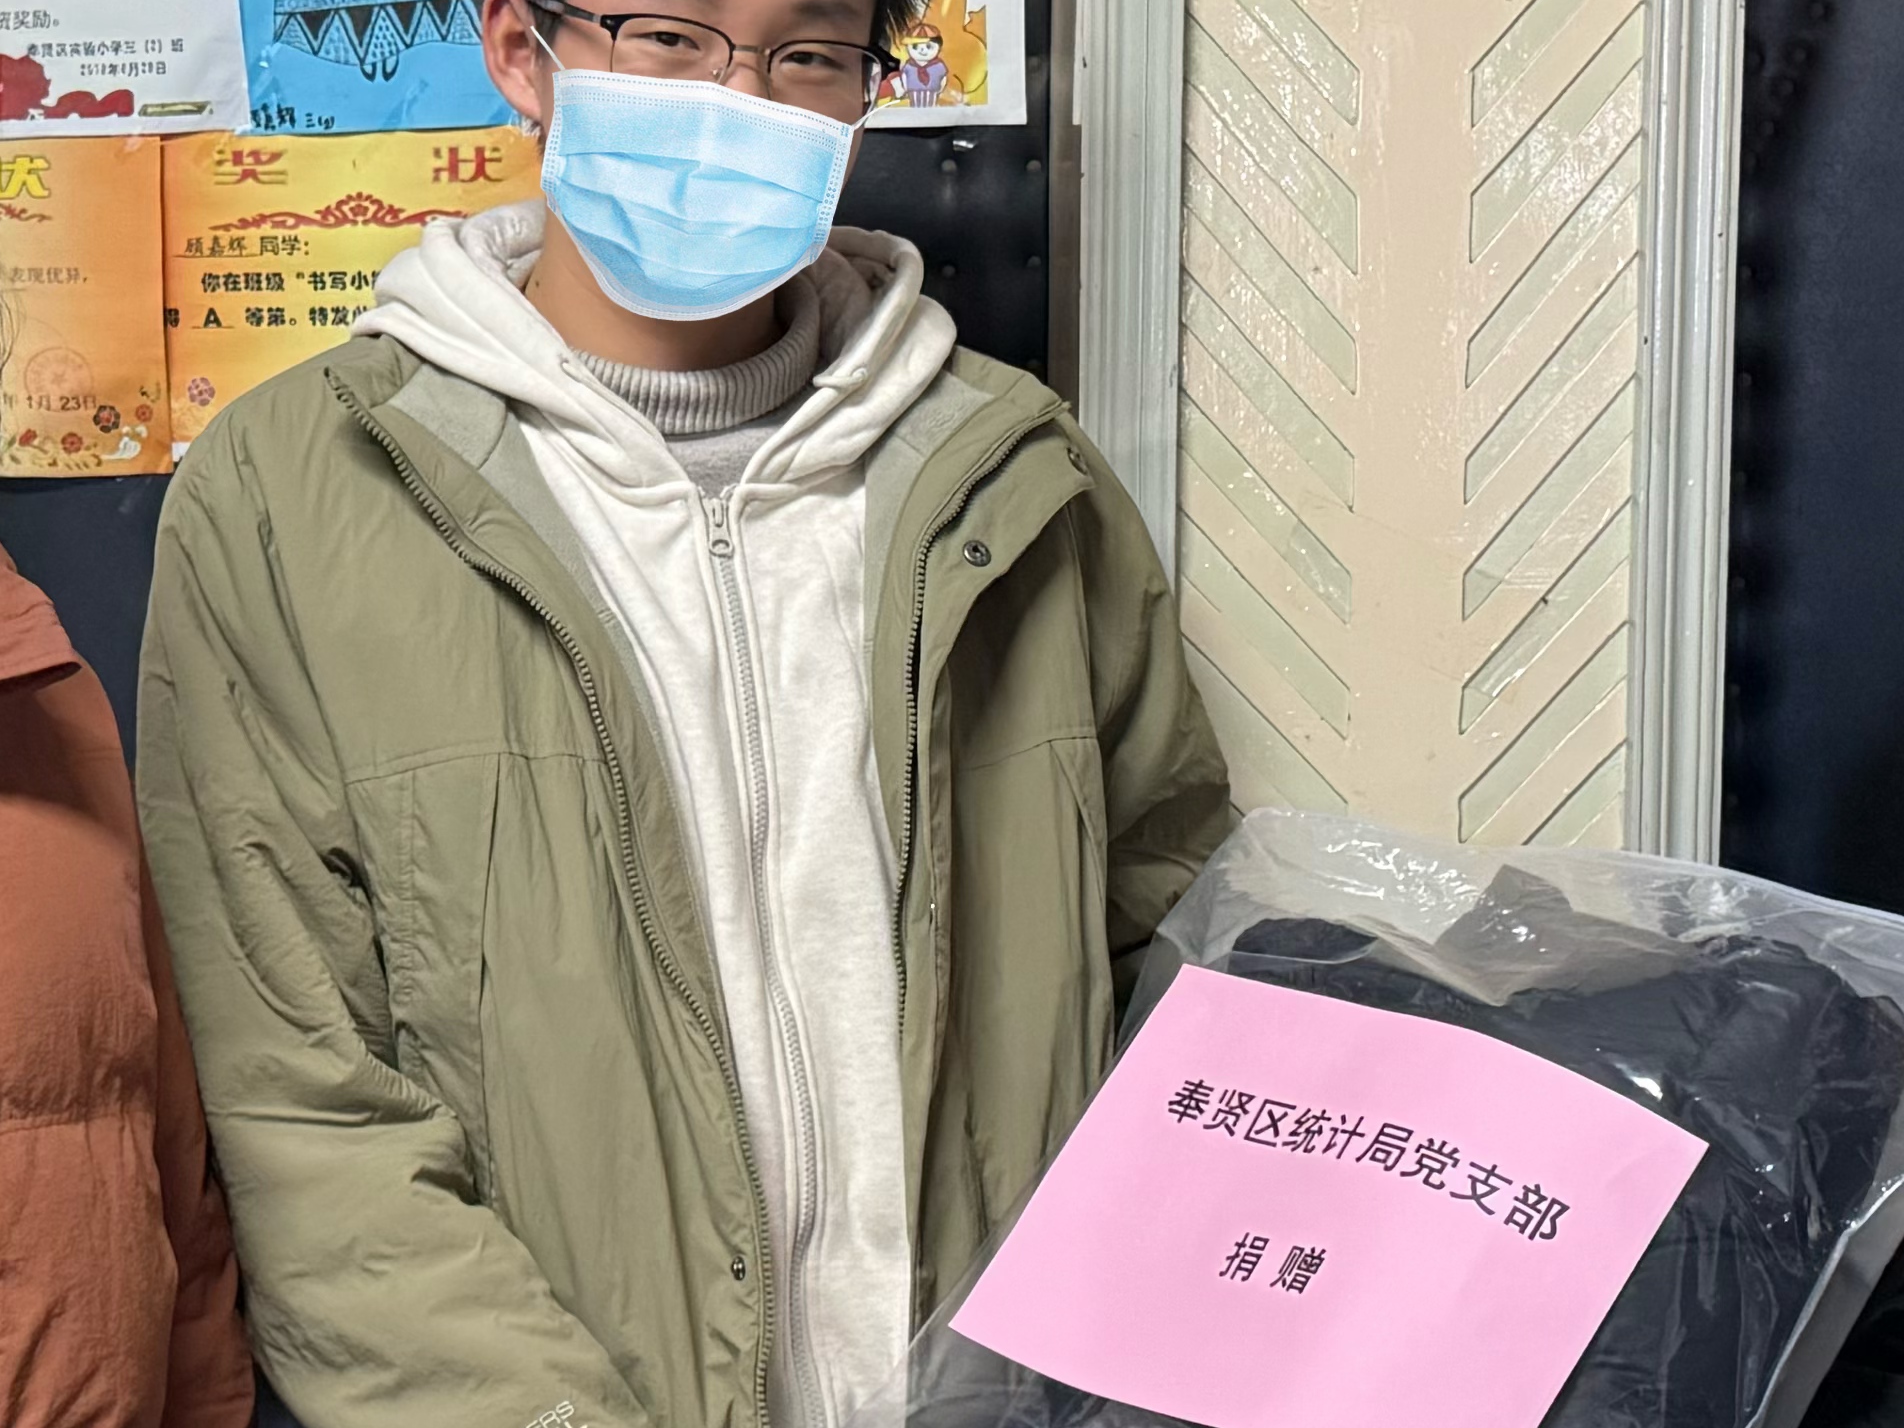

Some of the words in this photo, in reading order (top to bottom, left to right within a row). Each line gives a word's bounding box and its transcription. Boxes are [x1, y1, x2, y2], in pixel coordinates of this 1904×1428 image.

[213, 148, 289, 185] 奖
[432, 145, 505, 183] 状
[201, 271, 380, 293] 你在班级“书写小
[202, 307, 223, 328] A
[1167, 1078, 1571, 1243] 奉贤区统计局党支部
[1218, 1232, 1326, 1296] 捐赠
